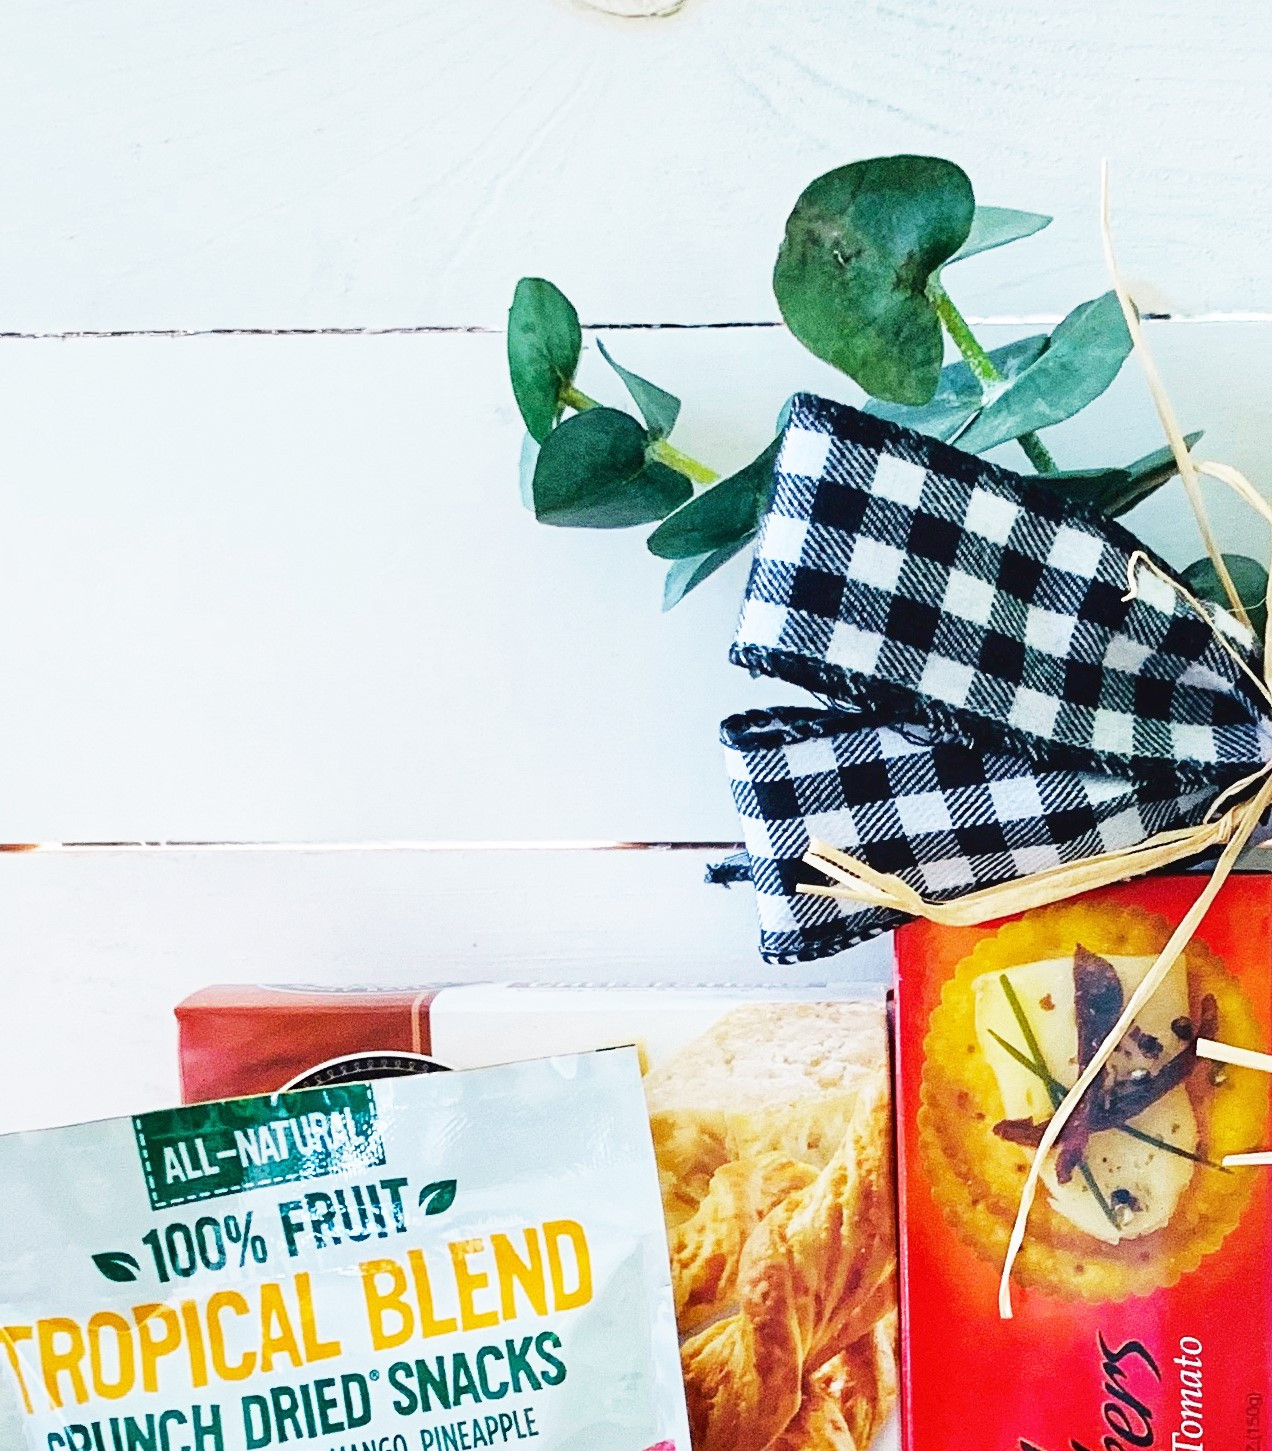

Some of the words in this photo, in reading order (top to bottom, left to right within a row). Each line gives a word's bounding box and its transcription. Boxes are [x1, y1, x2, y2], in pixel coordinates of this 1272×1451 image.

[163, 1107, 364, 1184] ALL-NATURAL
[143, 1212, 267, 1282] 100%
[280, 1178, 409, 1257] FRUIT
[0, 1273, 340, 1415] TROPICAL
[360, 1219, 593, 1351] BLEND
[389, 1331, 568, 1416] SNACKS
